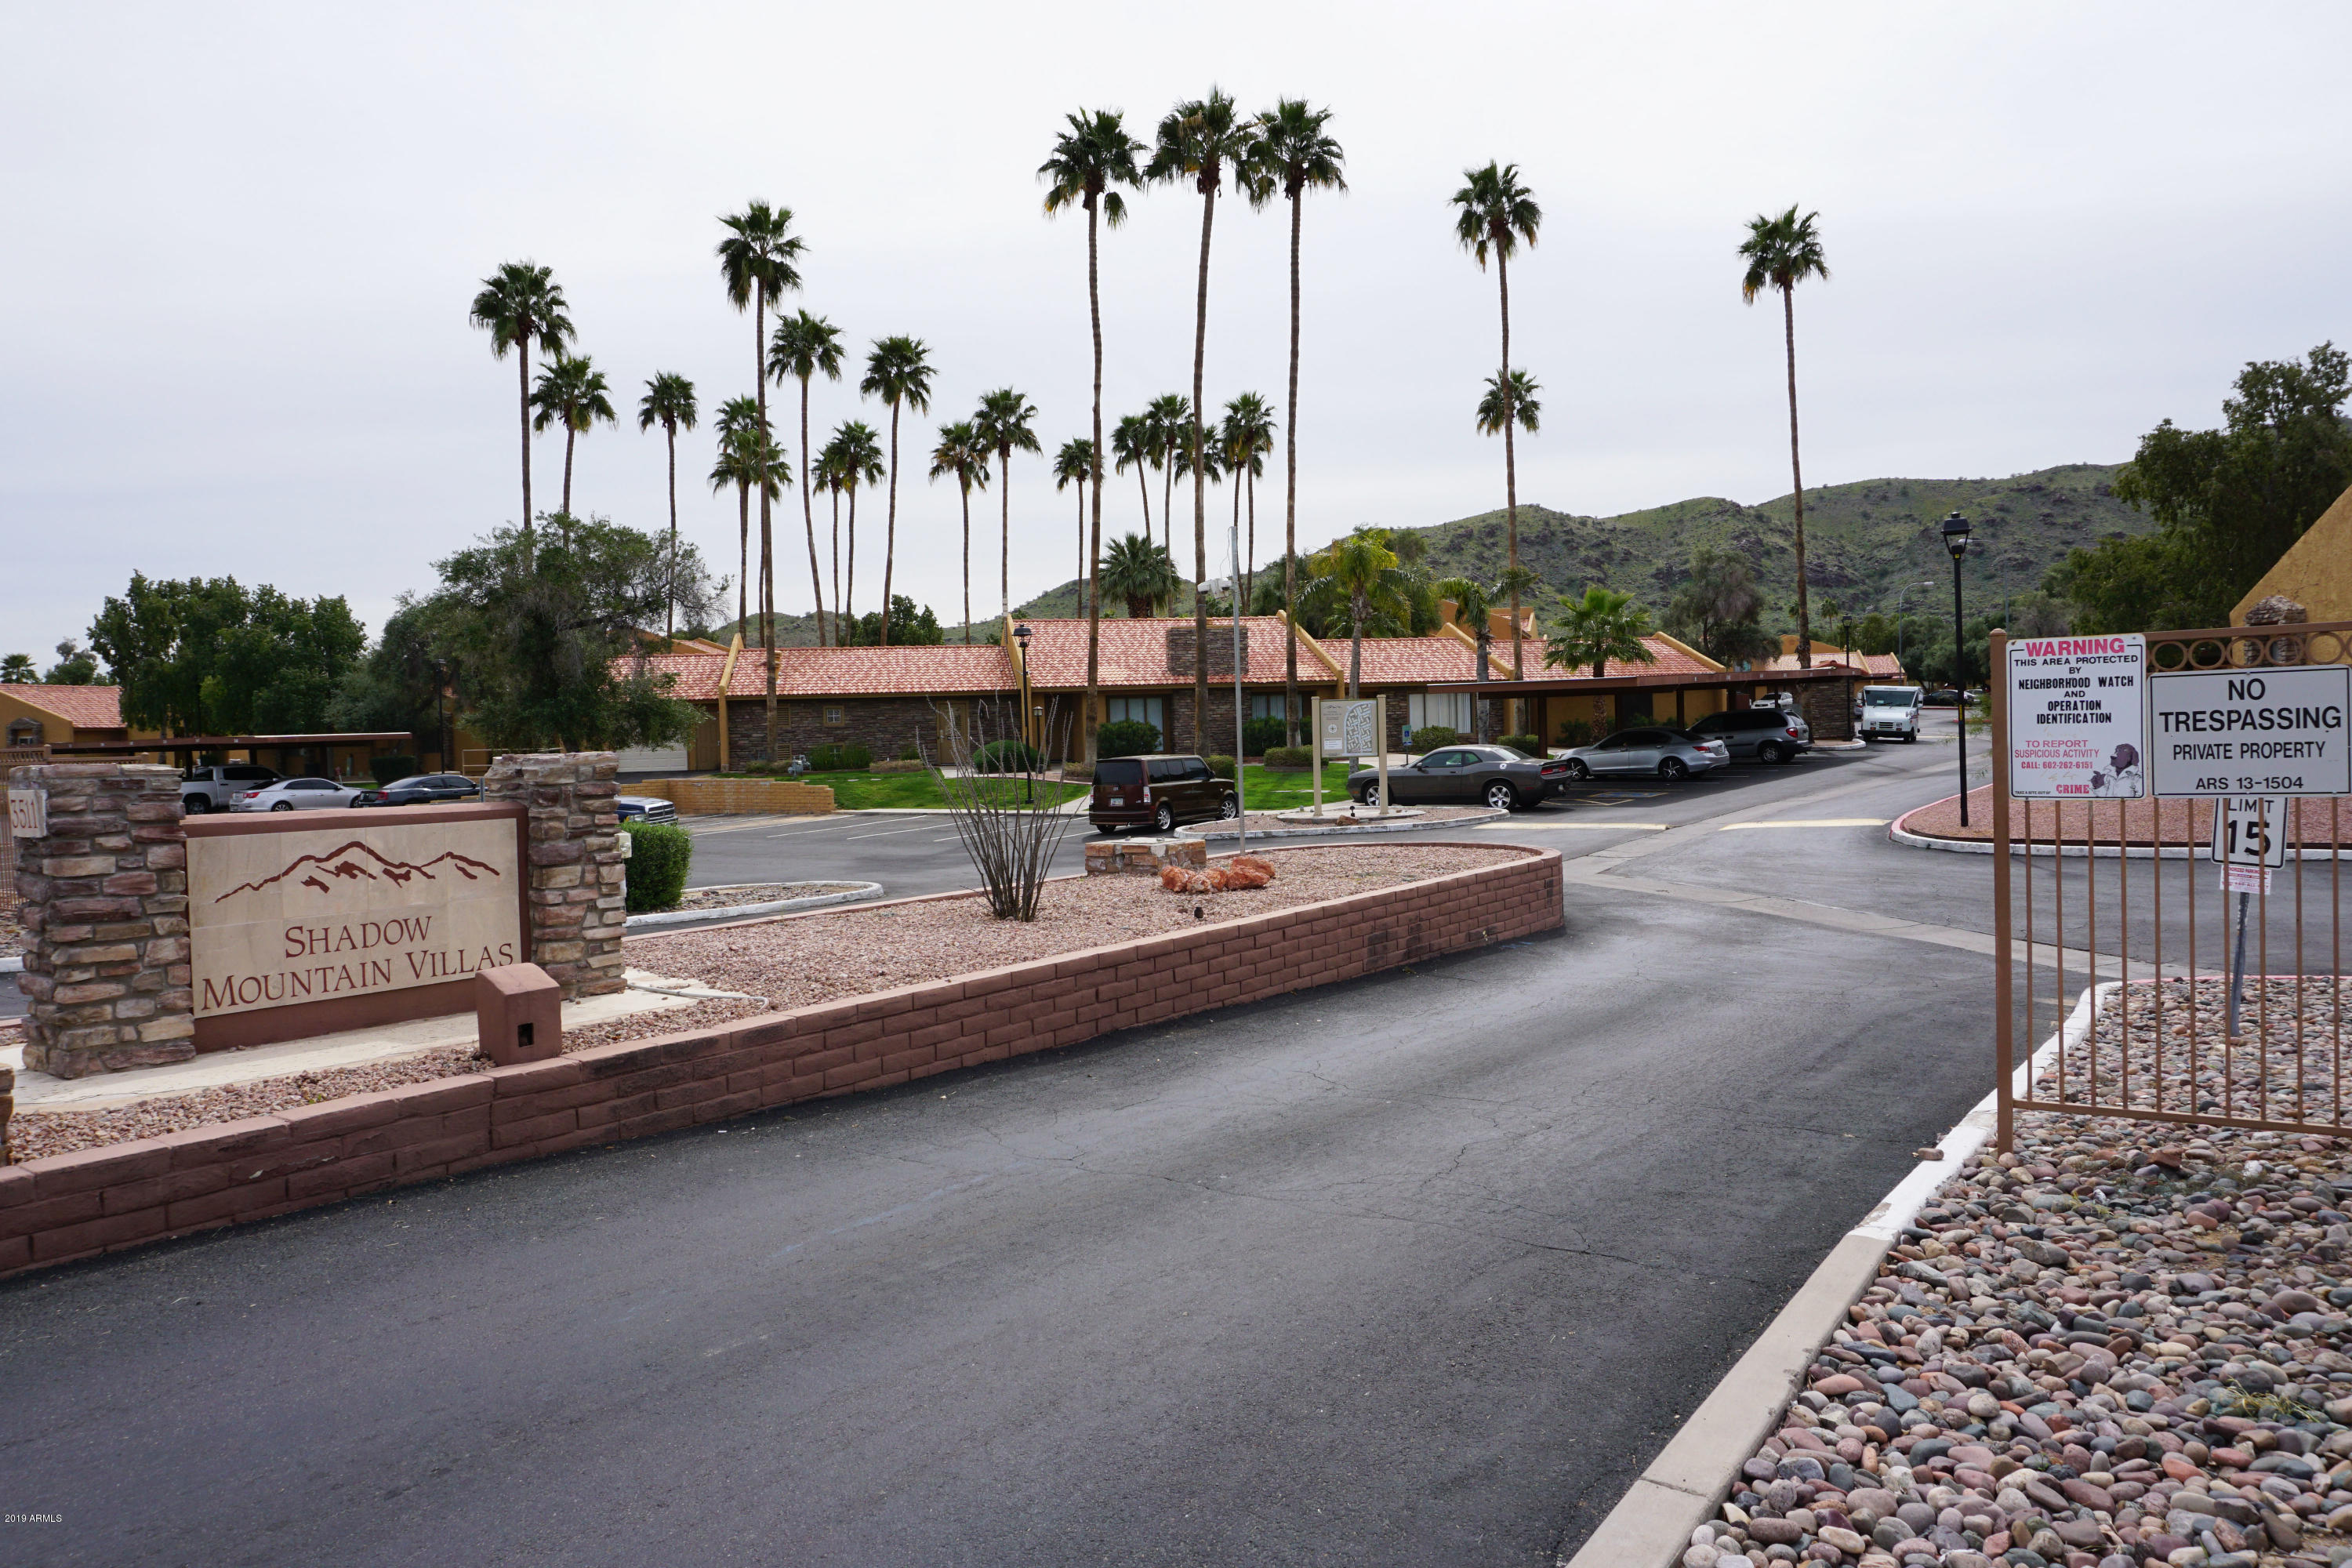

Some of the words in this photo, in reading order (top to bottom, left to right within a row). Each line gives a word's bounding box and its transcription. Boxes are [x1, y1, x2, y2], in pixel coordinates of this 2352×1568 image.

[2026, 637, 2125, 657] WARNING
[2042, 657, 2071, 666] AREA
[2076, 655, 2138, 664] PROTECTED
[2019, 677, 2090, 690] NEIGHBORHOOD
[2098, 676, 2133, 688] WATCH
[2228, 678, 2266, 701] NO
[2048, 700, 2101, 711] OPERATION
[2036, 712, 2112, 724] IDENTIFICATION
[2158, 706, 2342, 732] TRESPASSING
[2042, 739, 2089, 748] REPORT
[2173, 743, 2233, 760] PRIVATE
[2241, 741, 2325, 759] PROPERTY
[2014, 750, 2060, 758] SUSPICIOUS
[2063, 749, 2100, 758] ACTIVITY
[2042, 760, 2093, 769] 602-262-6151
[2056, 784, 2089, 794] CRIME
[2195, 777, 2229, 790] ARS
[2236, 776, 2304, 789] 13-1504
[2228, 798, 2274, 813] LIMT
[2228, 819, 2271, 856] 15
[285, 916, 433, 959] SHADOW
[201, 958, 391, 1011] MOUNTAIN
[405, 943, 514, 980] VILLAS
